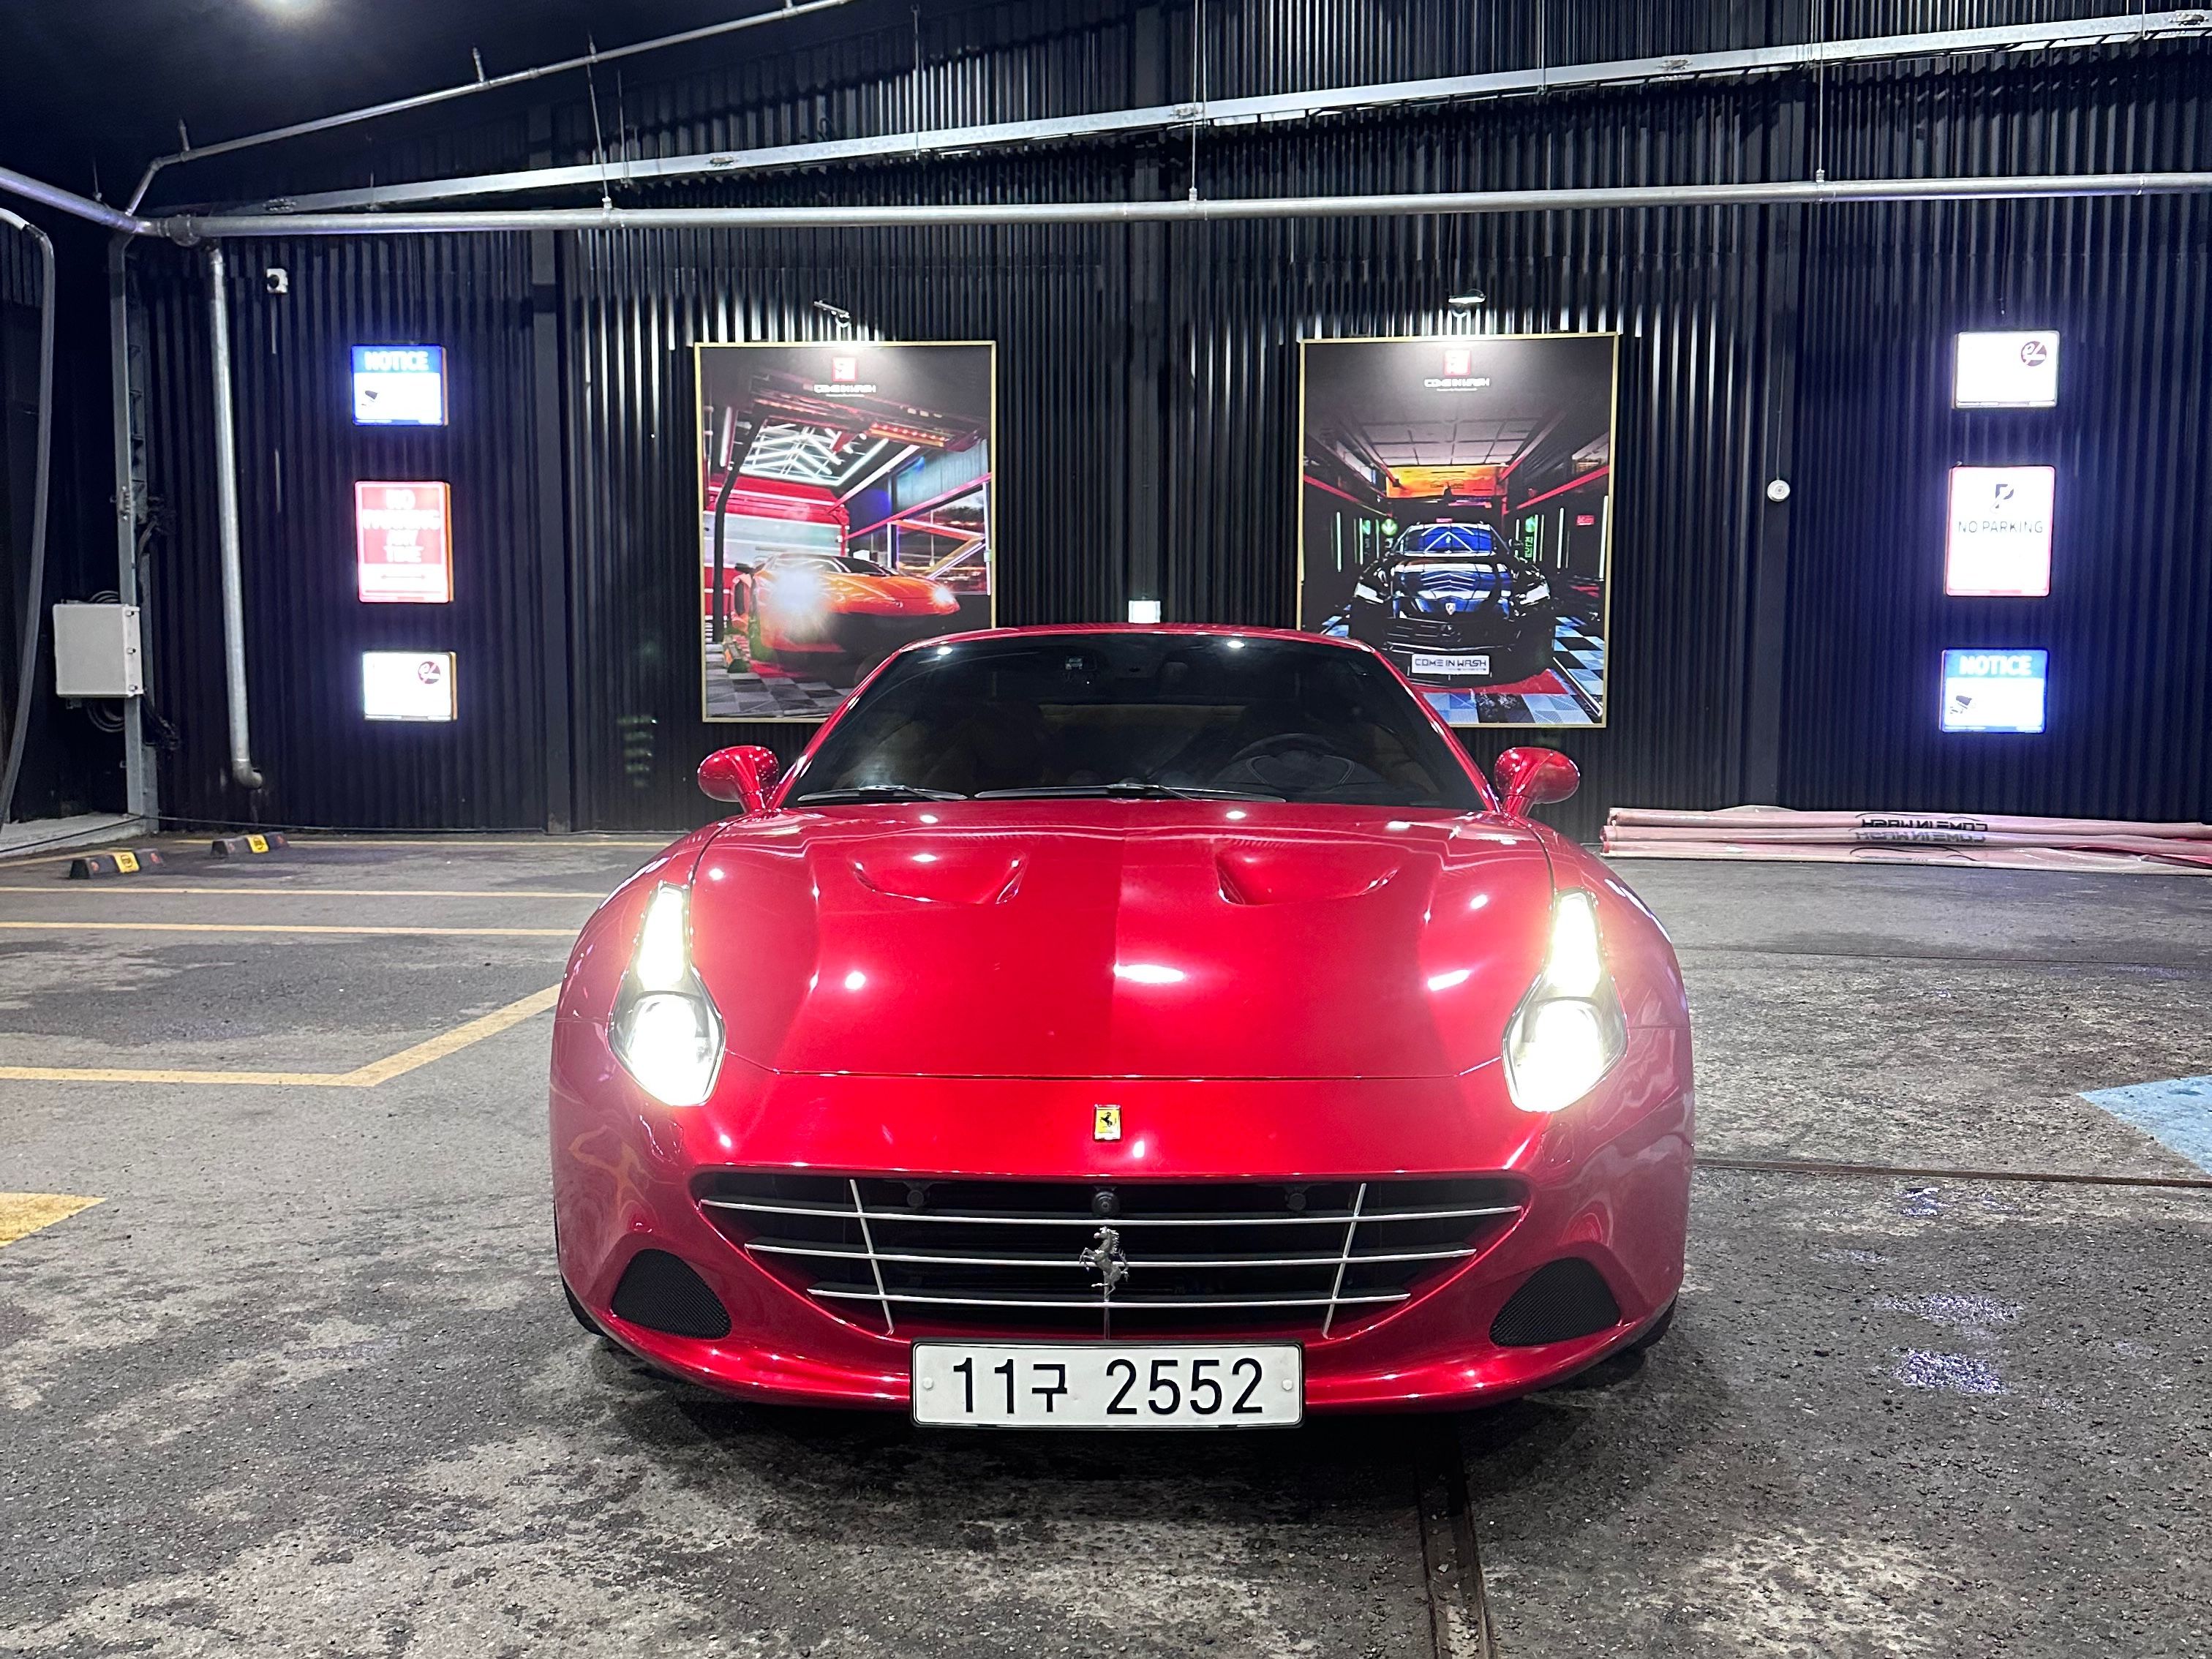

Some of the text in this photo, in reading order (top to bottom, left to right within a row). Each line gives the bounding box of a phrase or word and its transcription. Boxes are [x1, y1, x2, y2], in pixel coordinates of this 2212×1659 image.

[364, 351, 429, 370] NOTICE
[1958, 520, 2043, 533] NO PARKING
[1415, 658, 1444, 666] COME
[1960, 655, 2031, 675] NOTICE
[953, 1357, 1264, 1415] 11구 2552
